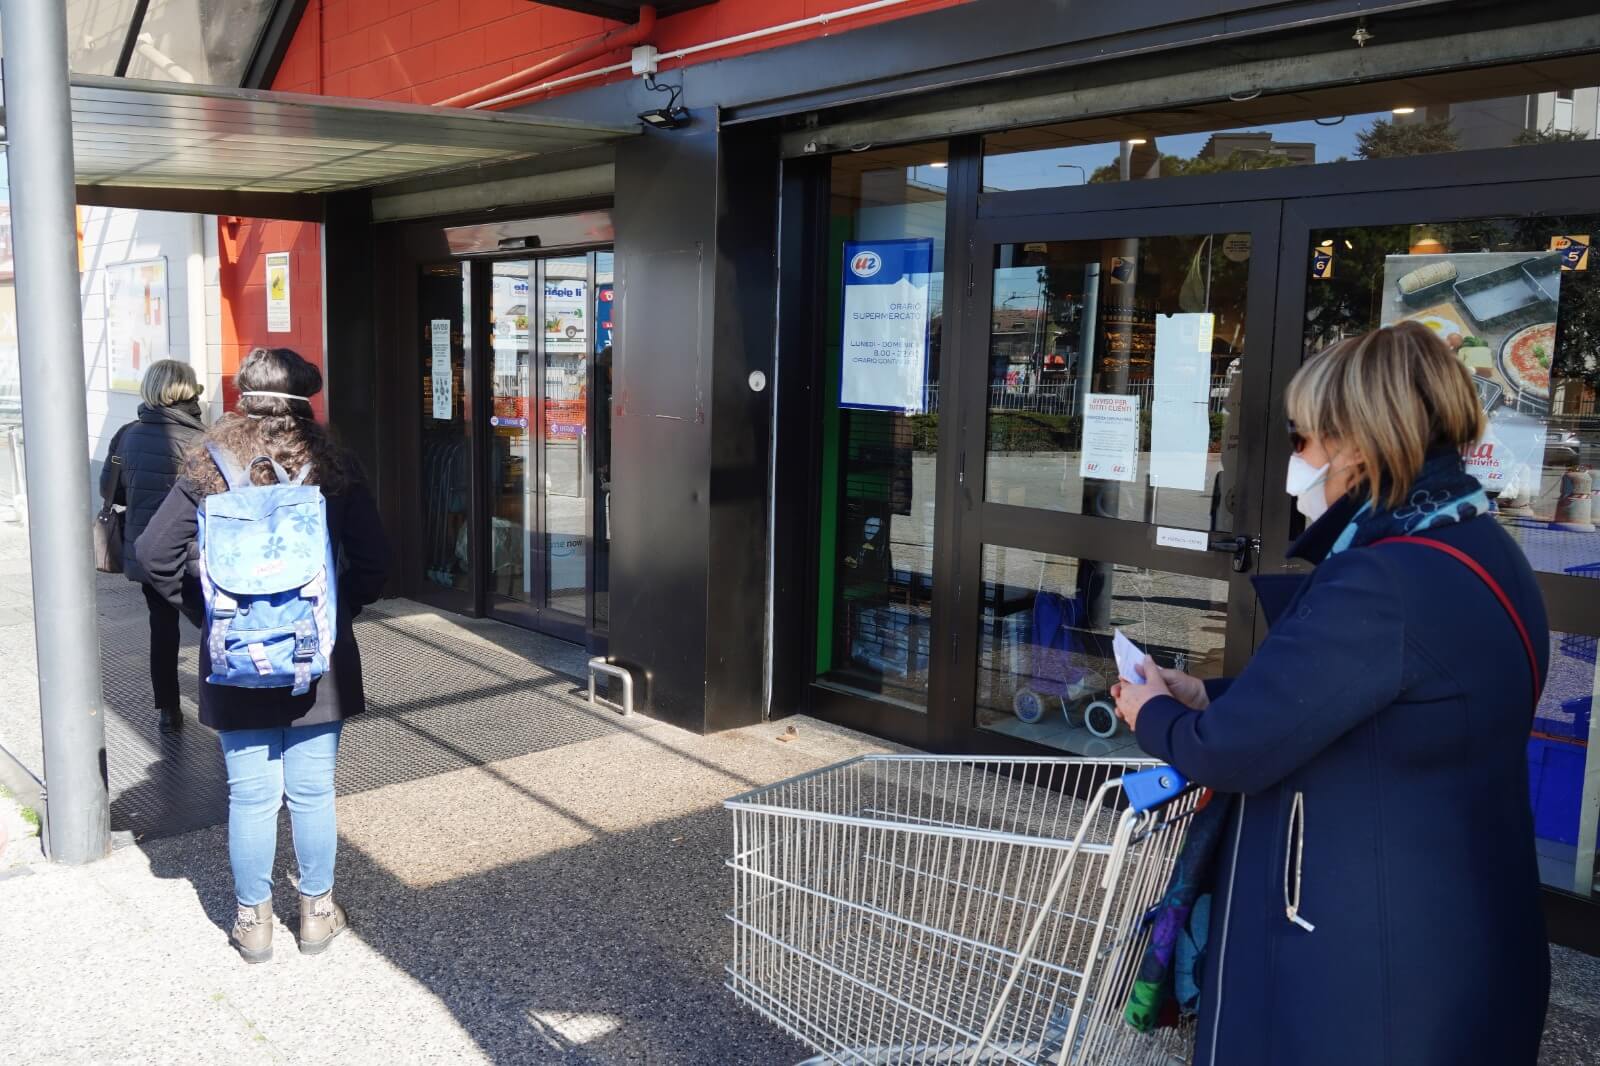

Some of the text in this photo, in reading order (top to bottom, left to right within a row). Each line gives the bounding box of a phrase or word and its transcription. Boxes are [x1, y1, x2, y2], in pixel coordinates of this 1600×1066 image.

[1568, 251, 1580, 262] 5
[1316, 261, 1325, 270] 6
[852, 312, 921, 320] SUPERMERCATO
